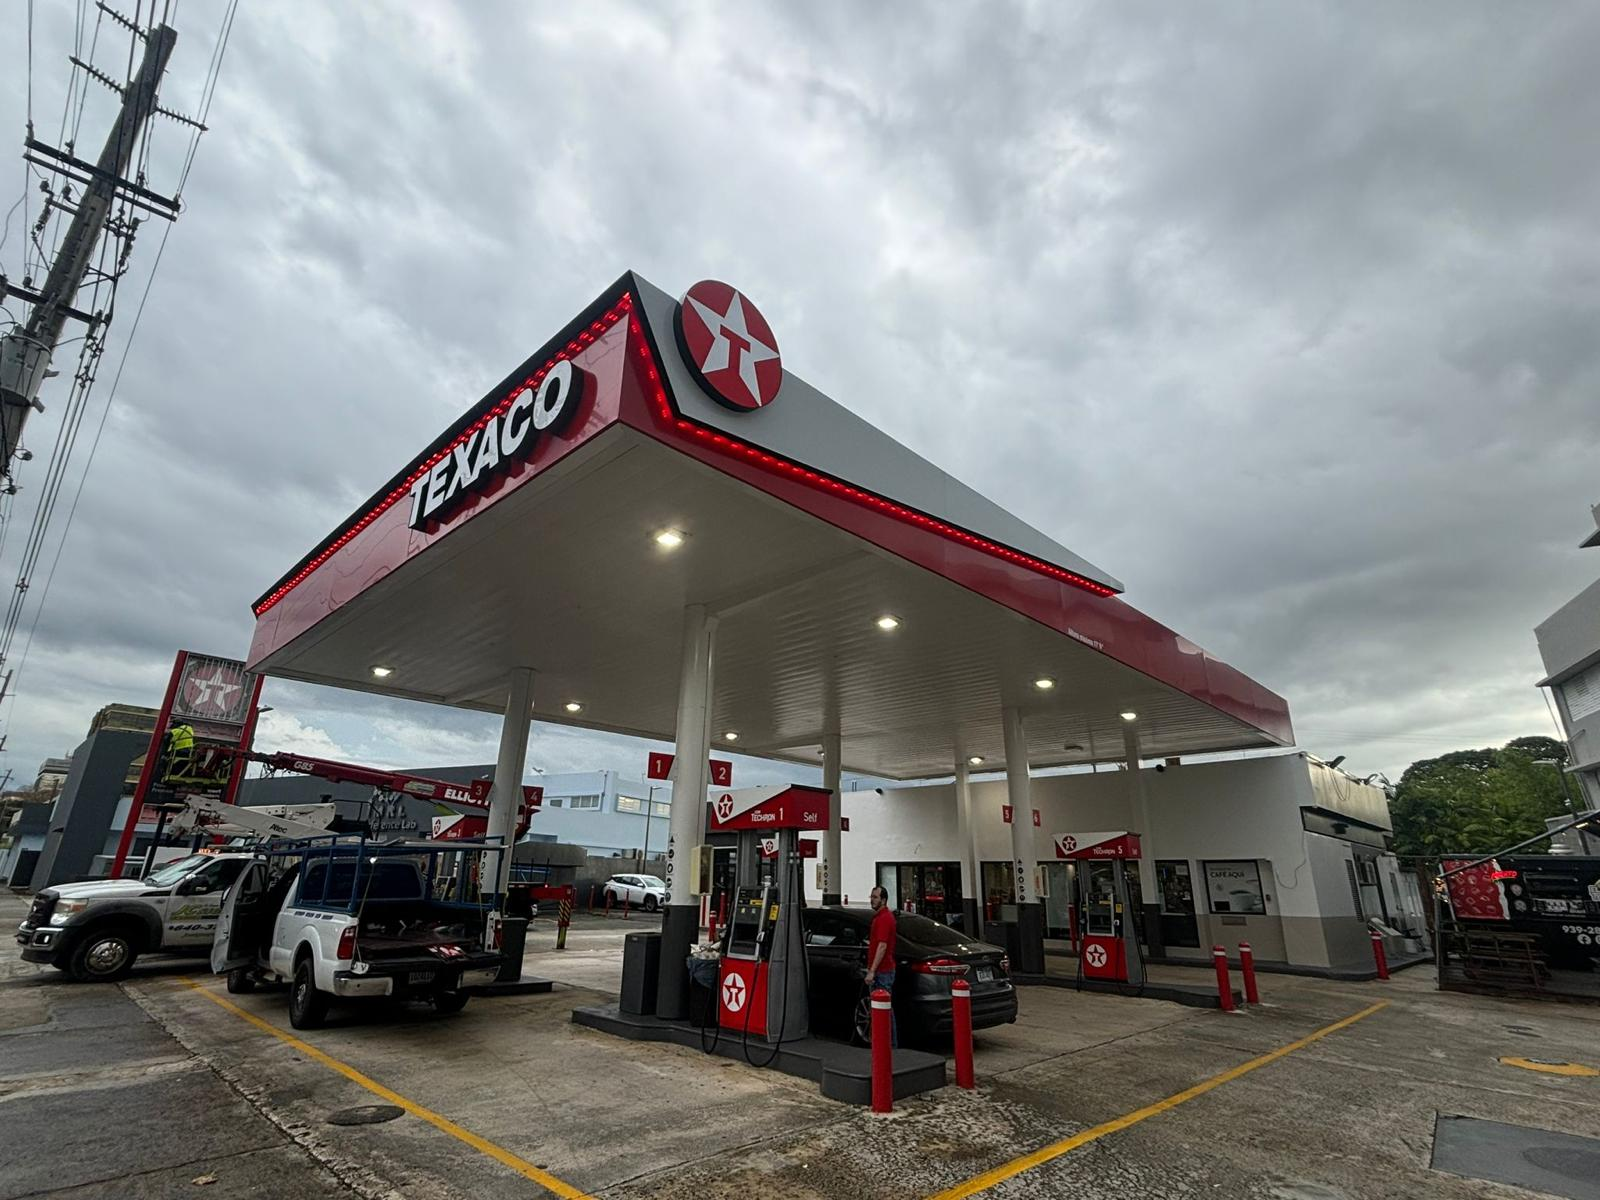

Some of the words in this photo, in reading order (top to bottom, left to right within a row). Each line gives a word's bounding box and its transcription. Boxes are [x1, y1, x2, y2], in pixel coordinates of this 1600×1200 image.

[408, 359, 573, 528] TEXACO
[293, 760, 315, 771] G85
[656, 759, 662, 773] 1
[718, 766, 727, 780] 2
[475, 785, 483, 796] 3
[530, 790, 538, 802] 4
[444, 788, 490, 807] ELLI
[779, 807, 784, 821] 1
[803, 811, 818, 823] Self
[1117, 845, 1123, 855] 5
